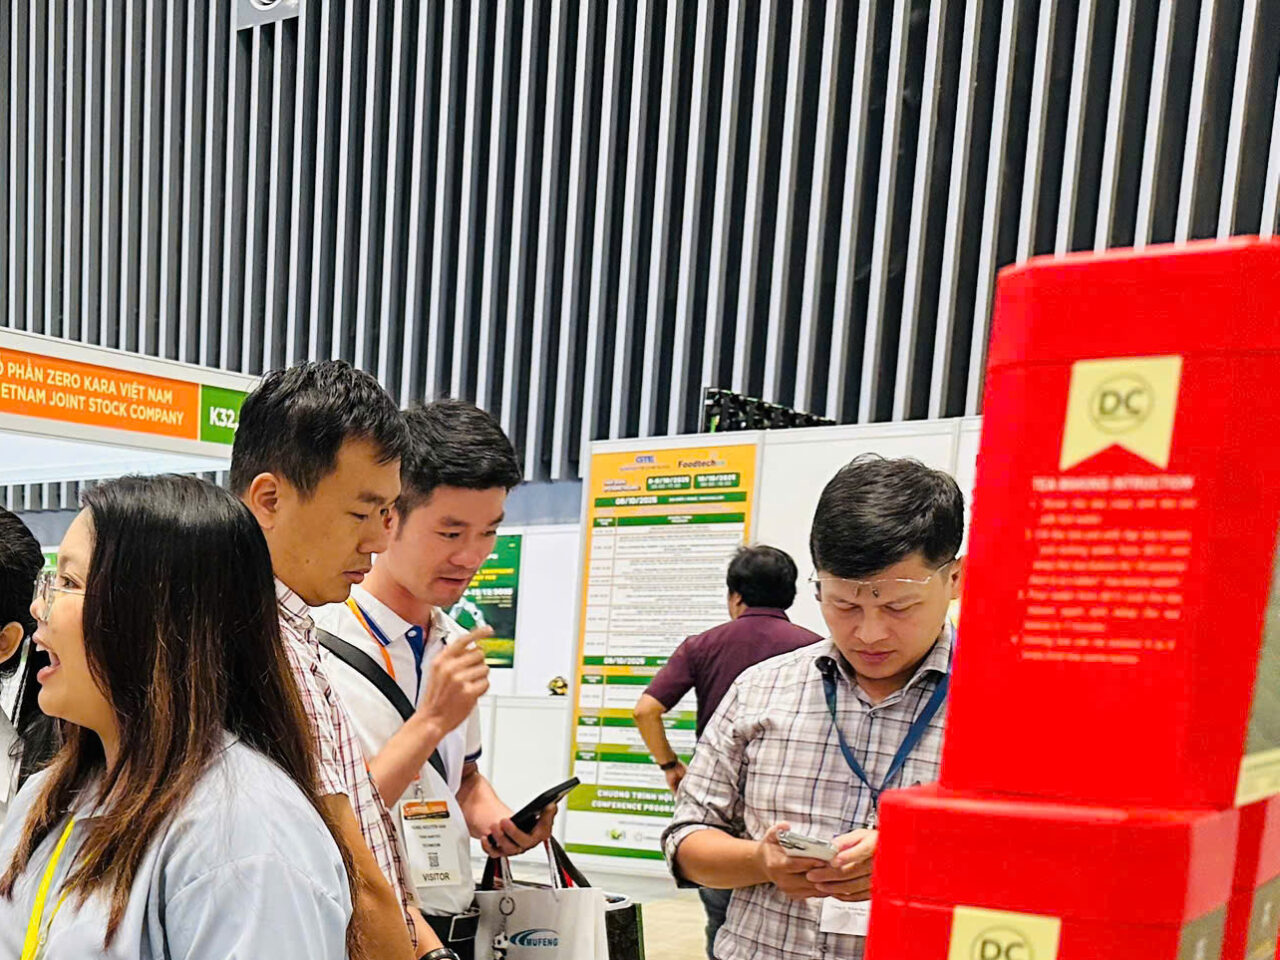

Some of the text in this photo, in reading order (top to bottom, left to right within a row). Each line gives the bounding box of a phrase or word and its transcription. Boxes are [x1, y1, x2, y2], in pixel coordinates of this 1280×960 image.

[7, 358, 44, 382] PHẦN
[46, 369, 80, 388] ZERO
[83, 376, 117, 396] KARA
[119, 381, 145, 400] VIỆT
[147, 388, 173, 404] NAM
[49, 391, 86, 411] JOINT
[88, 398, 127, 418] STOCK
[129, 404, 184, 426] COMPANY
[1098, 388, 1145, 417] DC
[209, 406, 239, 432] K32,
[422, 872, 450, 881] VISITOR
